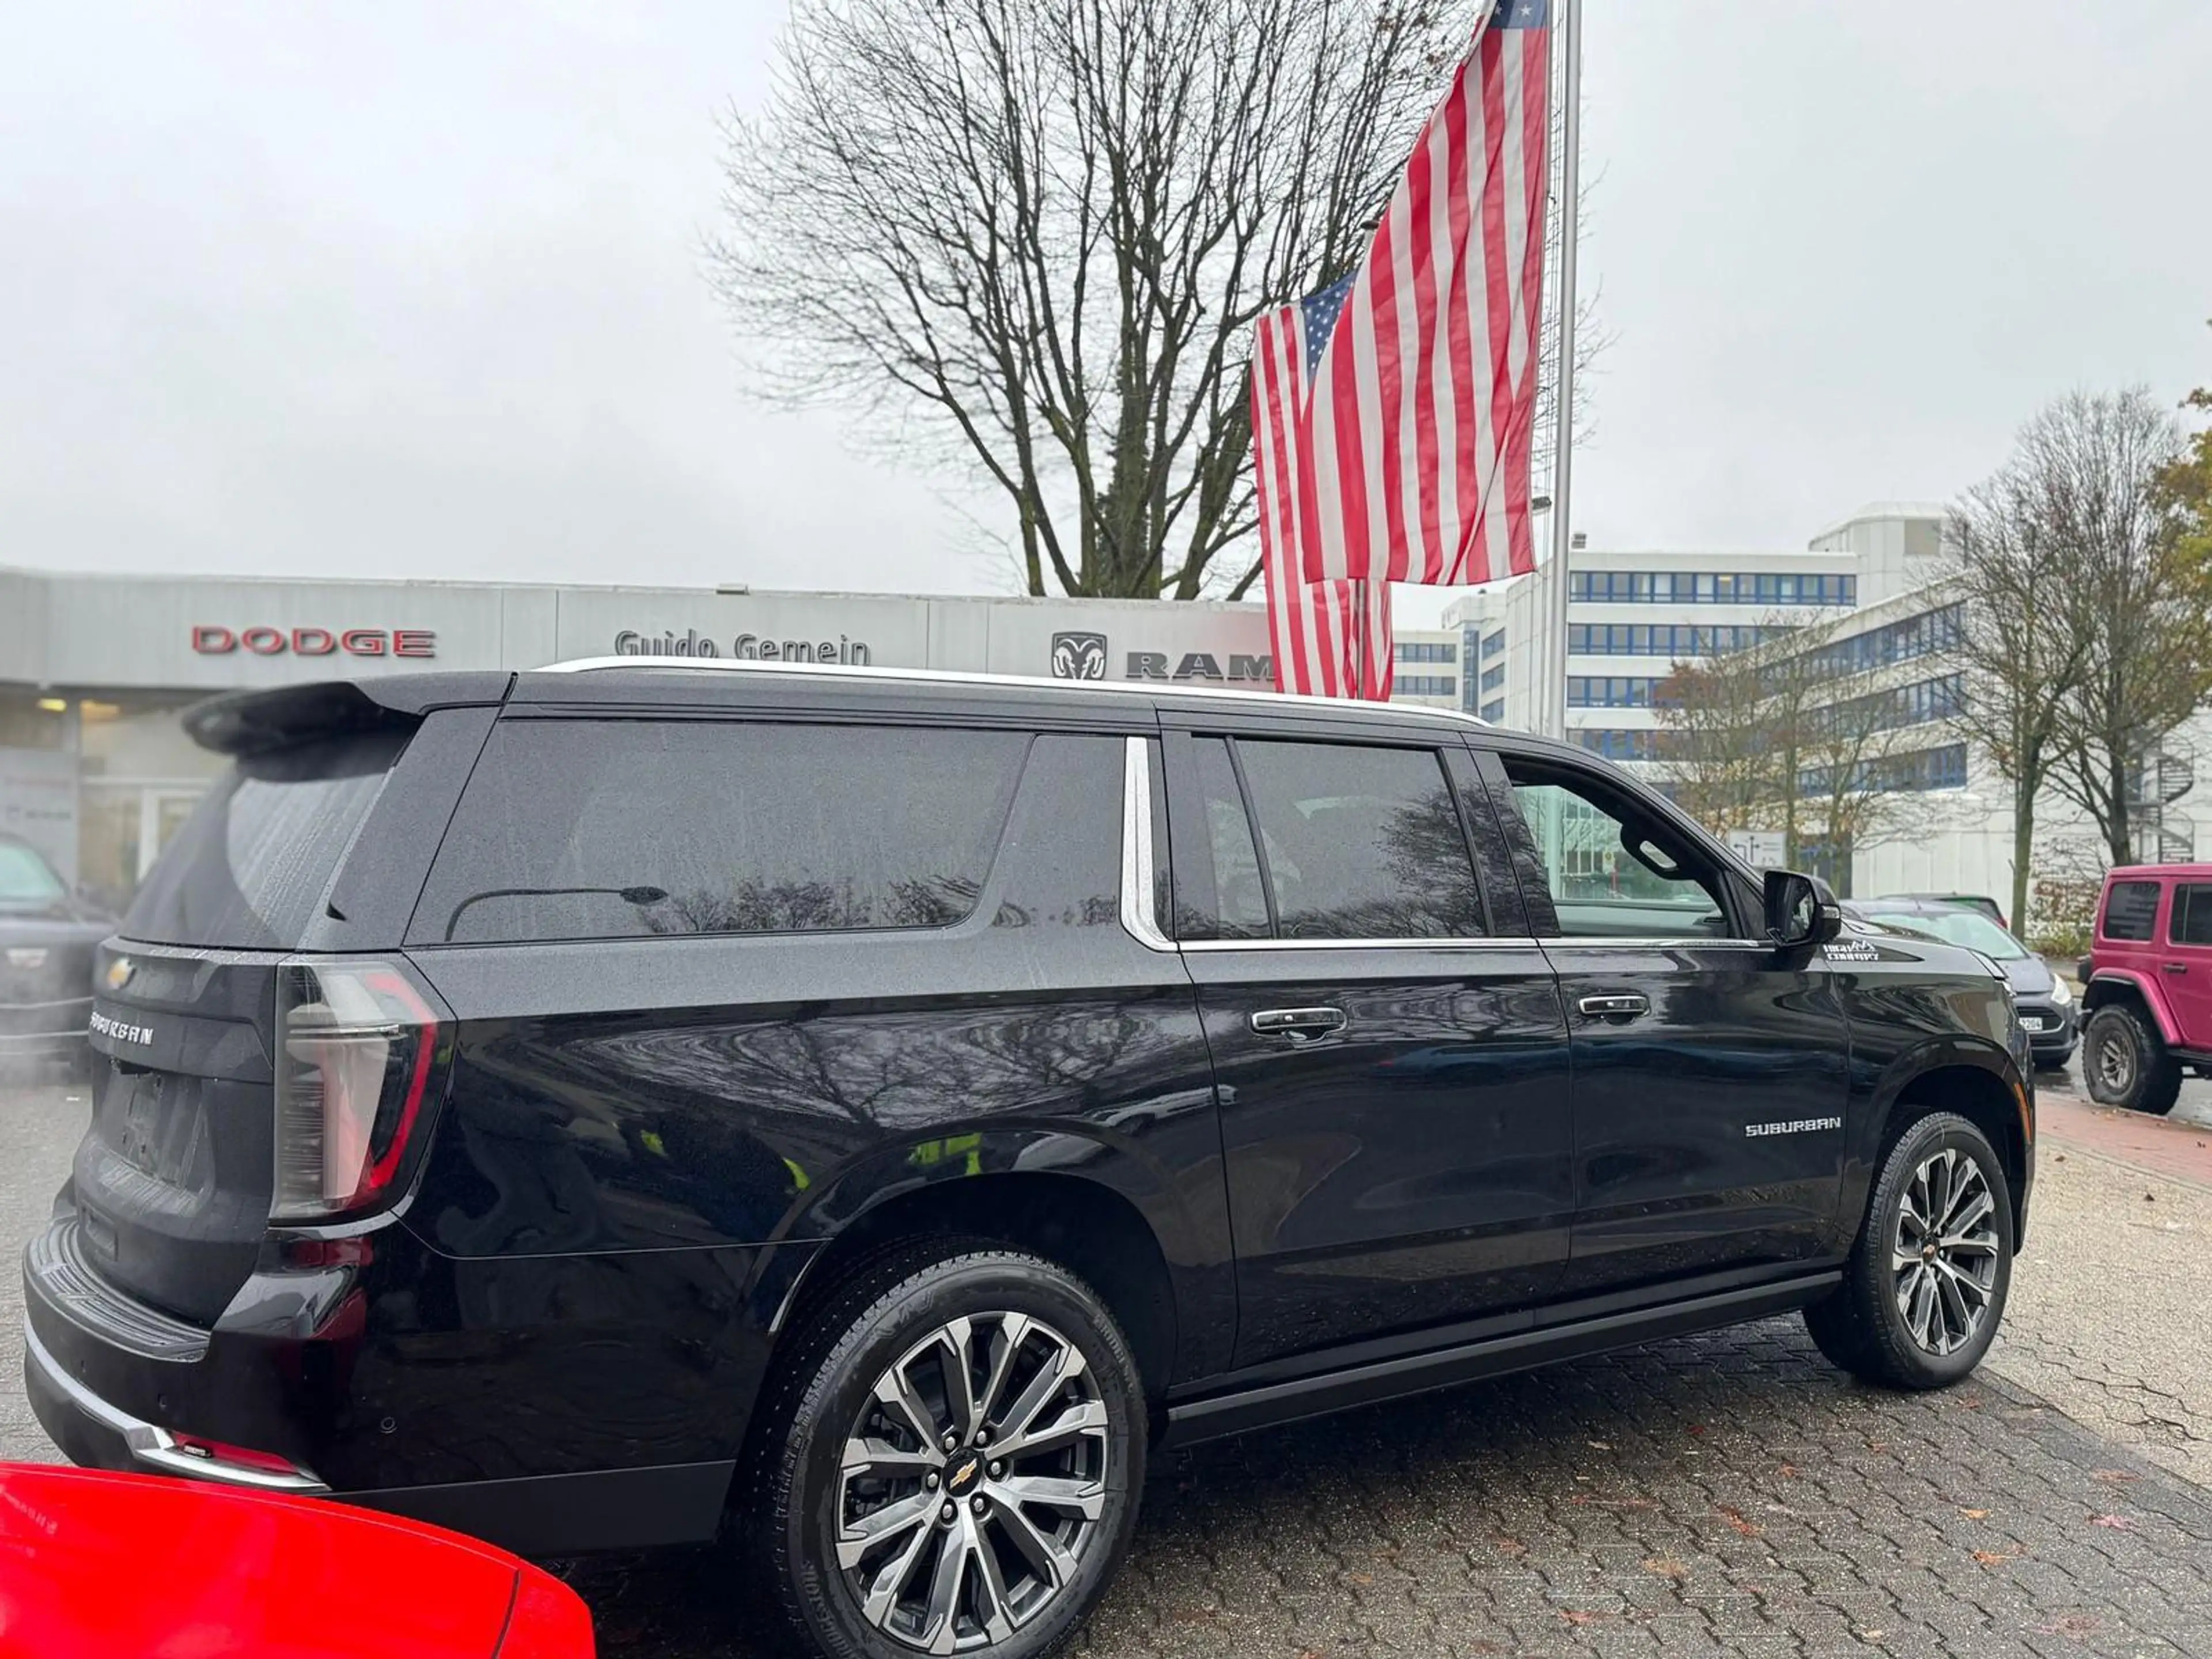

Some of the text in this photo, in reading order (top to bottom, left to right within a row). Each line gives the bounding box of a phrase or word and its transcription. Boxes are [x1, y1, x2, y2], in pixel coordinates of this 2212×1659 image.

[192, 626, 436, 657] DODGE
[615, 628, 870, 665] Guido Gemein
[1126, 652, 1276, 681] RAM
[1745, 1117, 1841, 1137] SUBURBAN
